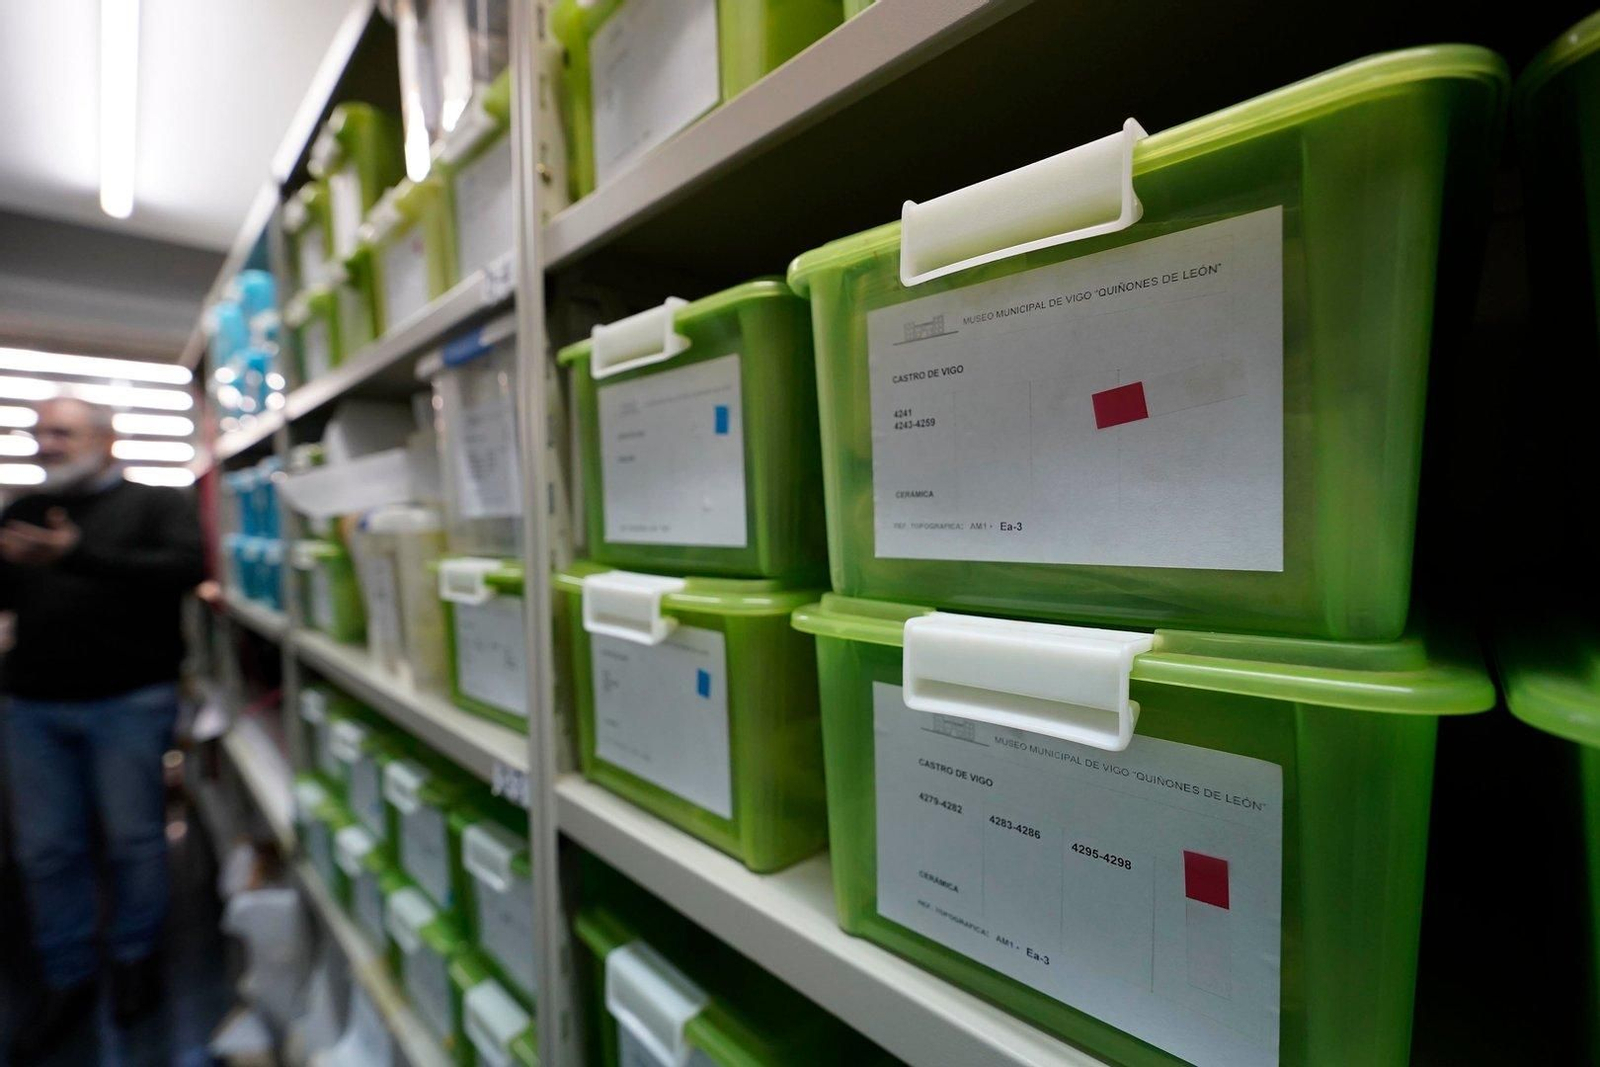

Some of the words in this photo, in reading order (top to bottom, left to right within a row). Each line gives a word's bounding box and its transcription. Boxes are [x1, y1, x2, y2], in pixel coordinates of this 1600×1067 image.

[963, 311, 994, 325] MUSEO
[996, 300, 1046, 318] MUNICIPAL
[1048, 296, 1063, 308] DE
[1065, 290, 1092, 304] VIGO
[1162, 272, 1179, 285] DE
[892, 371, 926, 384] CASTRO
[927, 368, 940, 379] DE
[941, 364, 964, 376] VIGO
[893, 408, 912, 419] 4241
[894, 417, 936, 430] 4243-4259
[1000, 521, 1023, 532] Ea-3
[918, 758, 953, 775] CASTRO
[955, 768, 968, 780] DE
[969, 773, 994, 787] VIGO
[994, 735, 1028, 751] MUSEO
[1029, 744, 1083, 766] MUNICIPAL
[1084, 758, 1100, 770] DE
[1102, 763, 1130, 777] VIGO
[1203, 788, 1222, 801] DE
[919, 792, 963, 814] 4279-4282
[989, 815, 1041, 840] 4283-4286
[1071, 843, 1132, 871] 4295-4298
[1026, 947, 1050, 966] Ea-3
